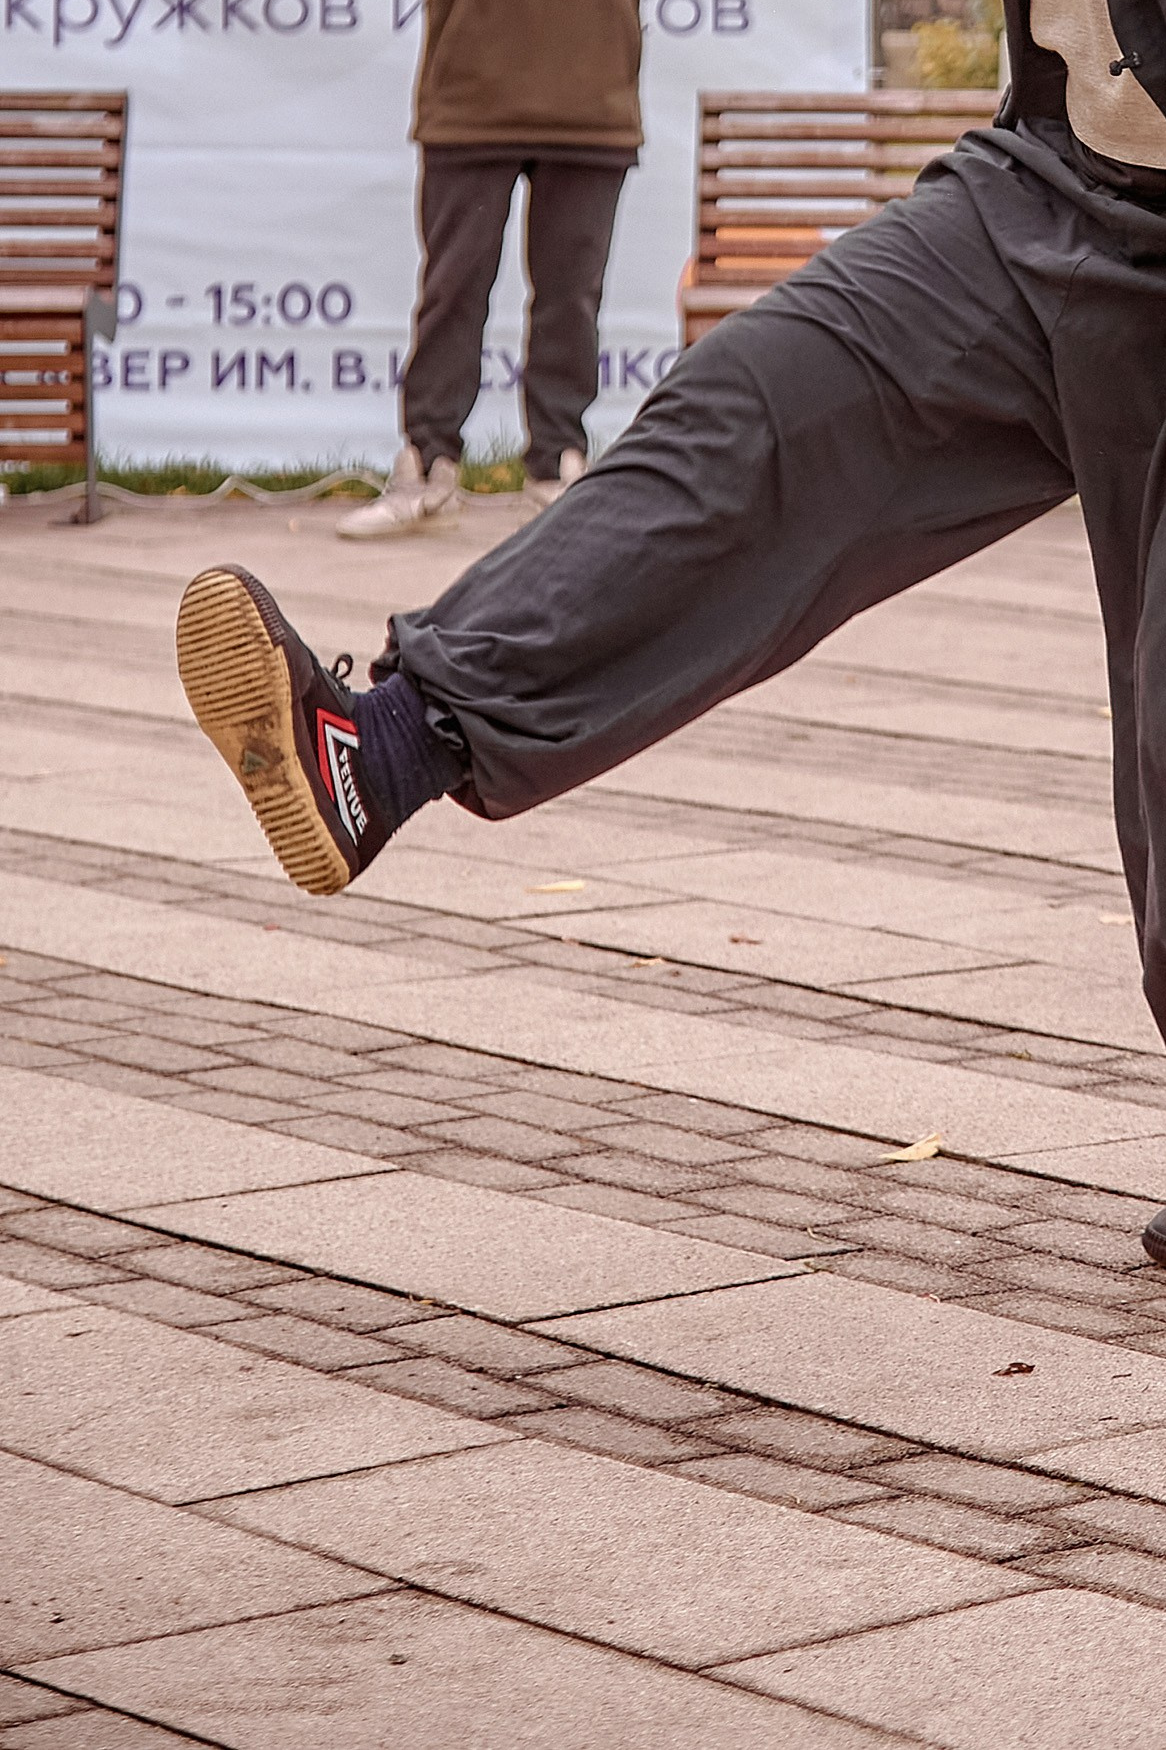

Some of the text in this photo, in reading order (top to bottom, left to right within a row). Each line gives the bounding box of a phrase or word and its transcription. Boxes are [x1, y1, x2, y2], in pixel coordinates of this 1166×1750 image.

[204, 281, 351, 325] 15:00
[209, 350, 310, 392] ИМ.
[338, 745, 369, 837] FEIYUE
